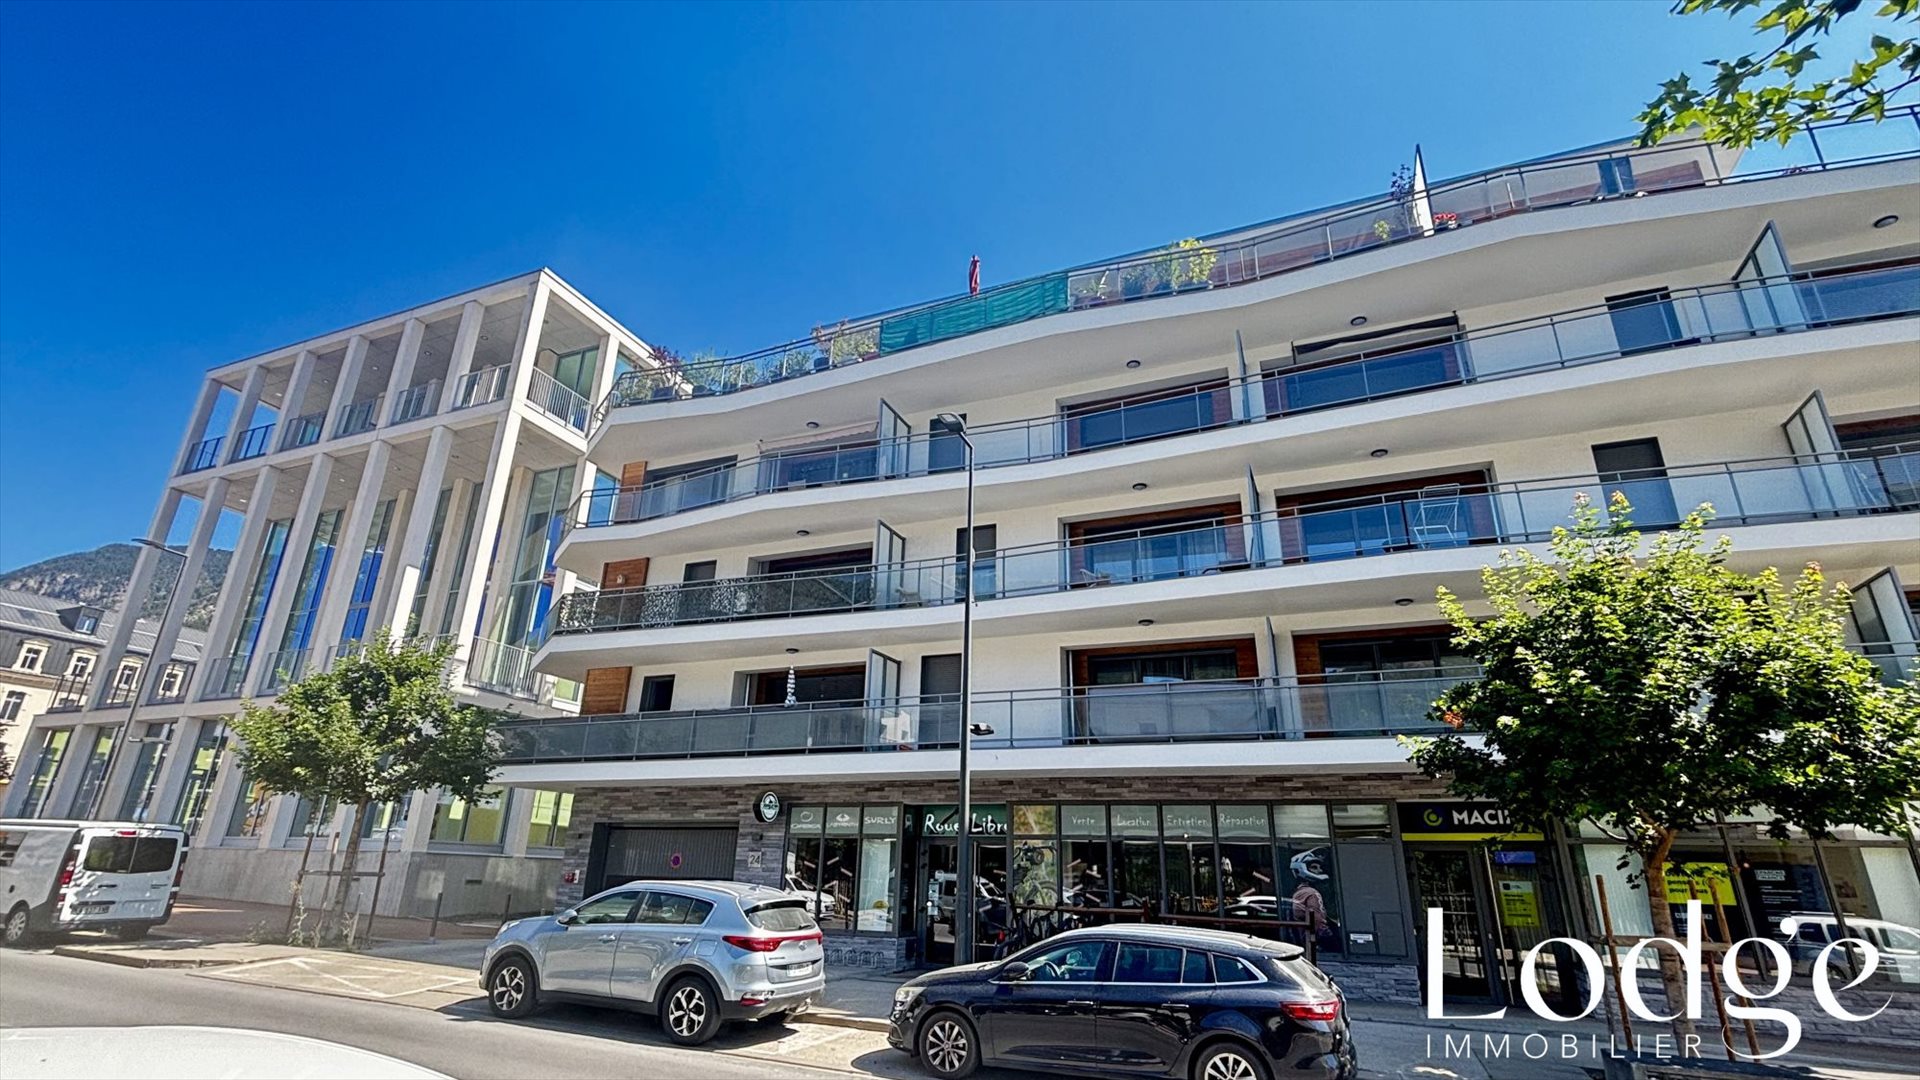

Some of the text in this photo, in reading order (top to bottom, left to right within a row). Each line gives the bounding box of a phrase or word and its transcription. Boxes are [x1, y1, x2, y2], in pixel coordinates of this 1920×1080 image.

[864, 815, 897, 825] SURLY
[924, 813, 960, 834] Roue
[1071, 815, 1096, 826] Vente
[1116, 814, 1152, 827] Location
[1166, 814, 1208, 827] Entretien
[1219, 812, 1266, 828] Réparation
[749, 855, 761, 865] 24
